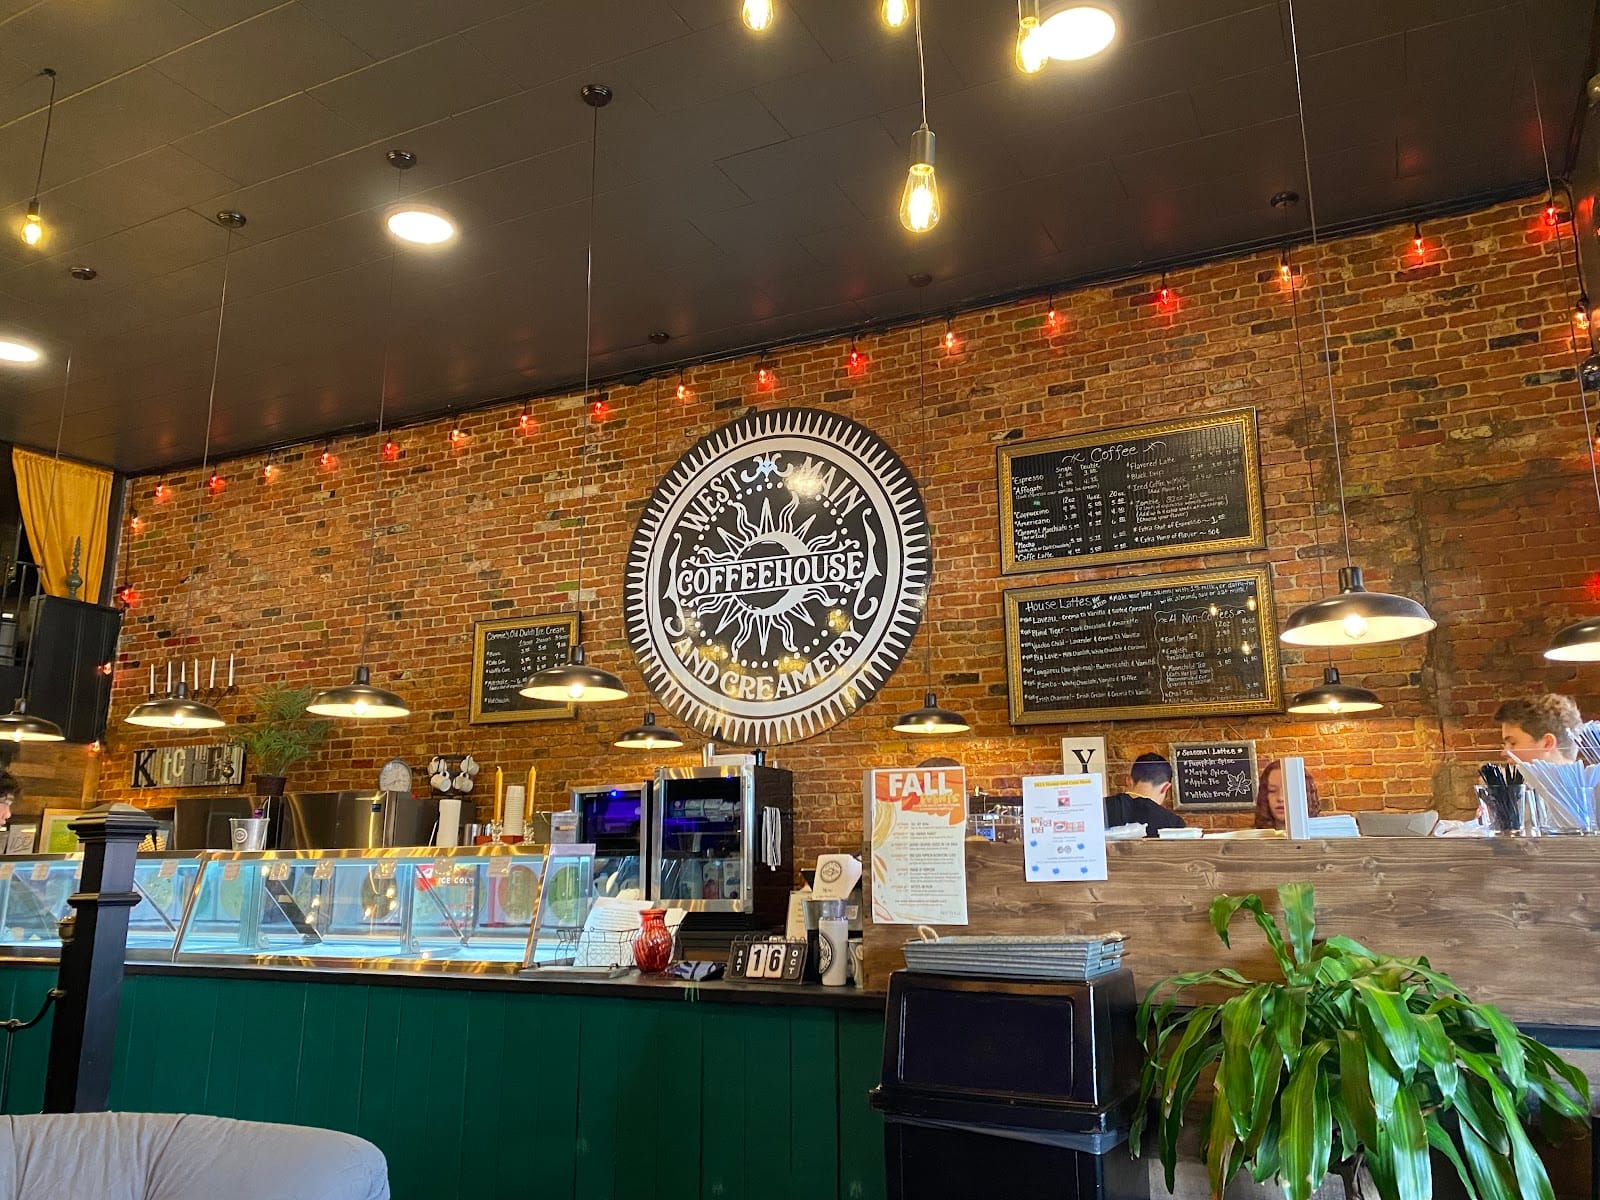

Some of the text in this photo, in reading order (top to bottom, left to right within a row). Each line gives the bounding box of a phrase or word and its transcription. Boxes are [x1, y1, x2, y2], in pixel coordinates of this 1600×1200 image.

[1091, 445, 1138, 462] Coffee
[1130, 457, 1175, 470] Flavored Latte
[1014, 474, 1044, 485] Espresso
[1131, 472, 1147, 480] Black
[679, 456, 866, 531] WEST MAIN
[1016, 518, 1051, 528] Americano
[1017, 541, 1036, 549] Mocha
[677, 553, 864, 596] COFFEEHOUSE
[1025, 600, 1058, 613] House
[1059, 596, 1093, 609] Lattes
[1182, 607, 1235, 625] Non-Cofees
[545, 626, 566, 635] Cream
[1050, 626, 1065, 638] Tiger
[672, 621, 864, 700] AND CREAMERY
[1182, 748, 1210, 757] Seasonal
[1072, 749, 1096, 773] Y
[1188, 758, 1235, 768] Pumpkin Spice
[1189, 768, 1229, 778] Maple Spice
[888, 772, 953, 797] FALL
[1190, 778, 1208, 787] Apple
[735, 949, 799, 975] SAT 16 OCT
